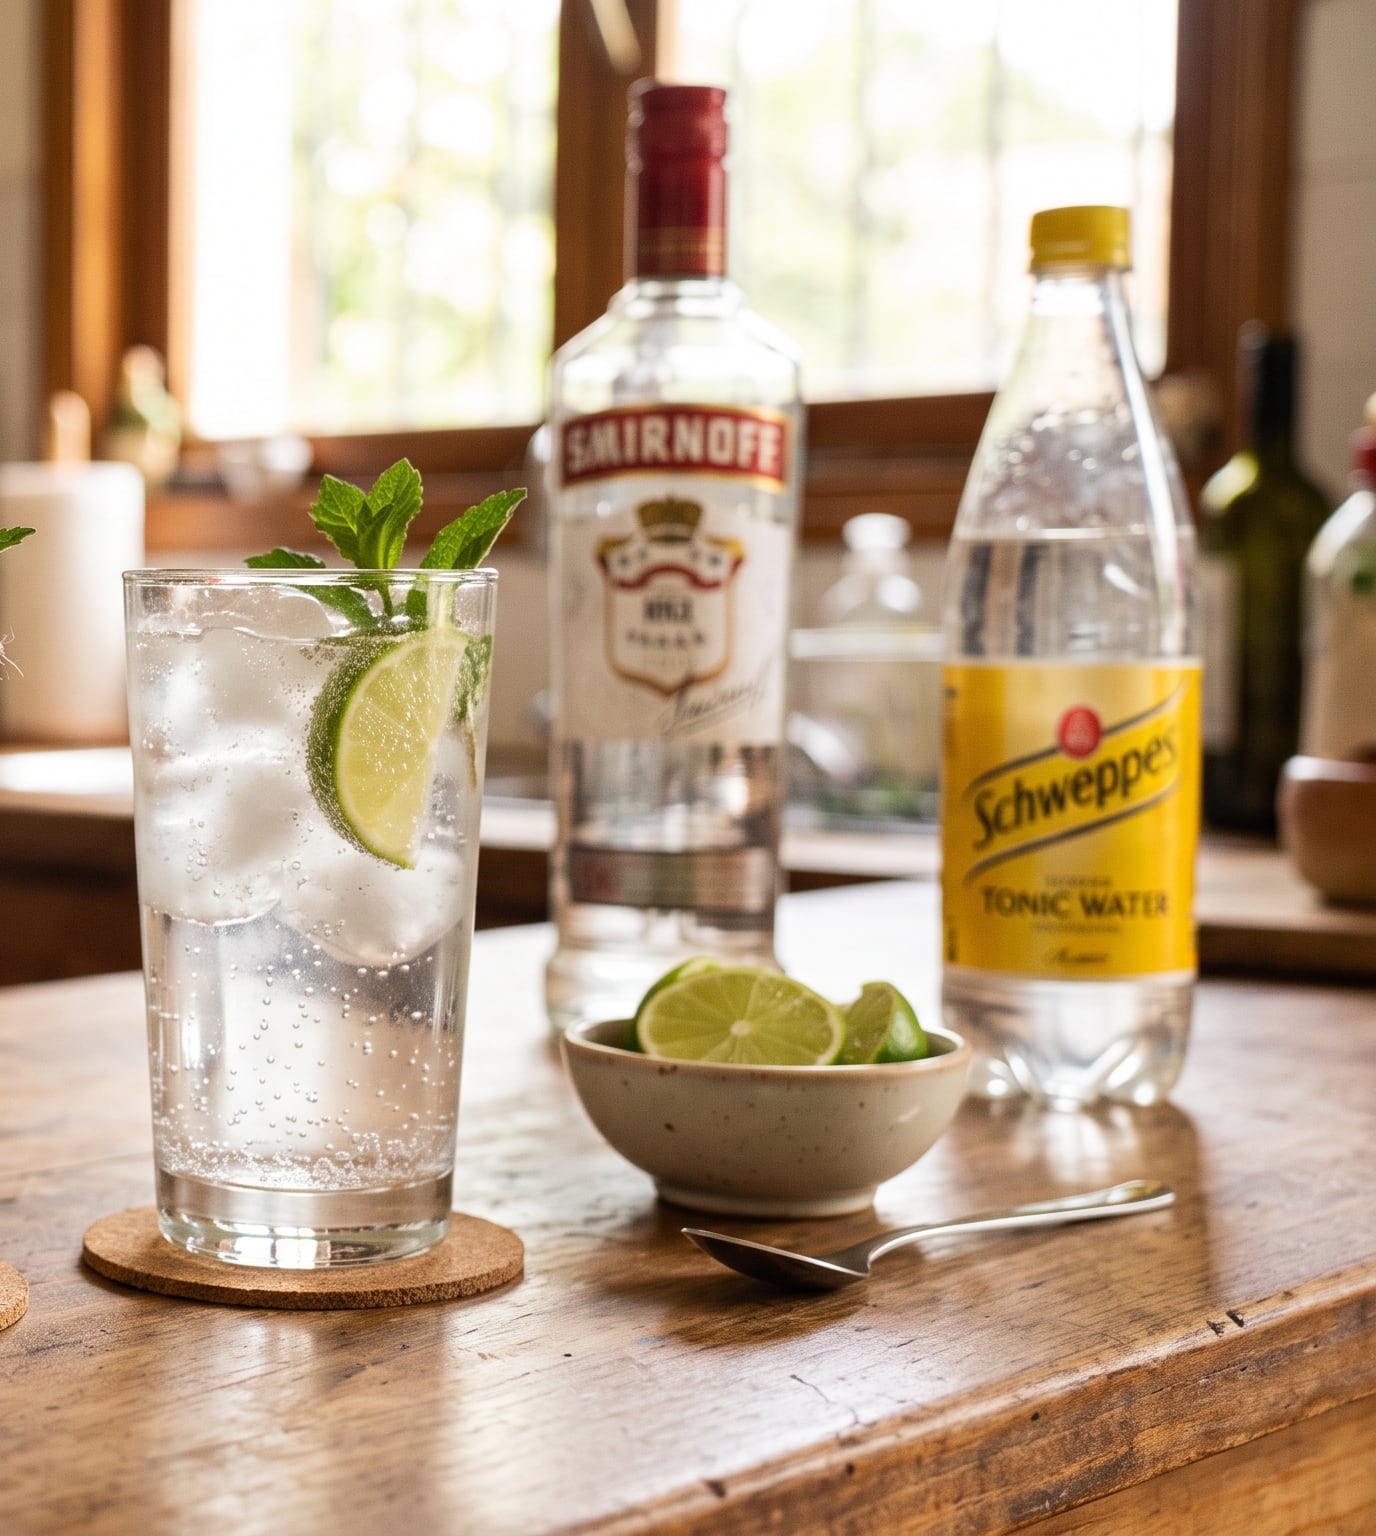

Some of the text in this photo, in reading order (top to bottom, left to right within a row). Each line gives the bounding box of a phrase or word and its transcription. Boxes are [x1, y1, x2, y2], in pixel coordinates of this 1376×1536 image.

[566, 415, 780, 474] SMIRNOFF
[974, 729, 1176, 849] Schweppes
[981, 886, 1167, 919] TONIC WATER
